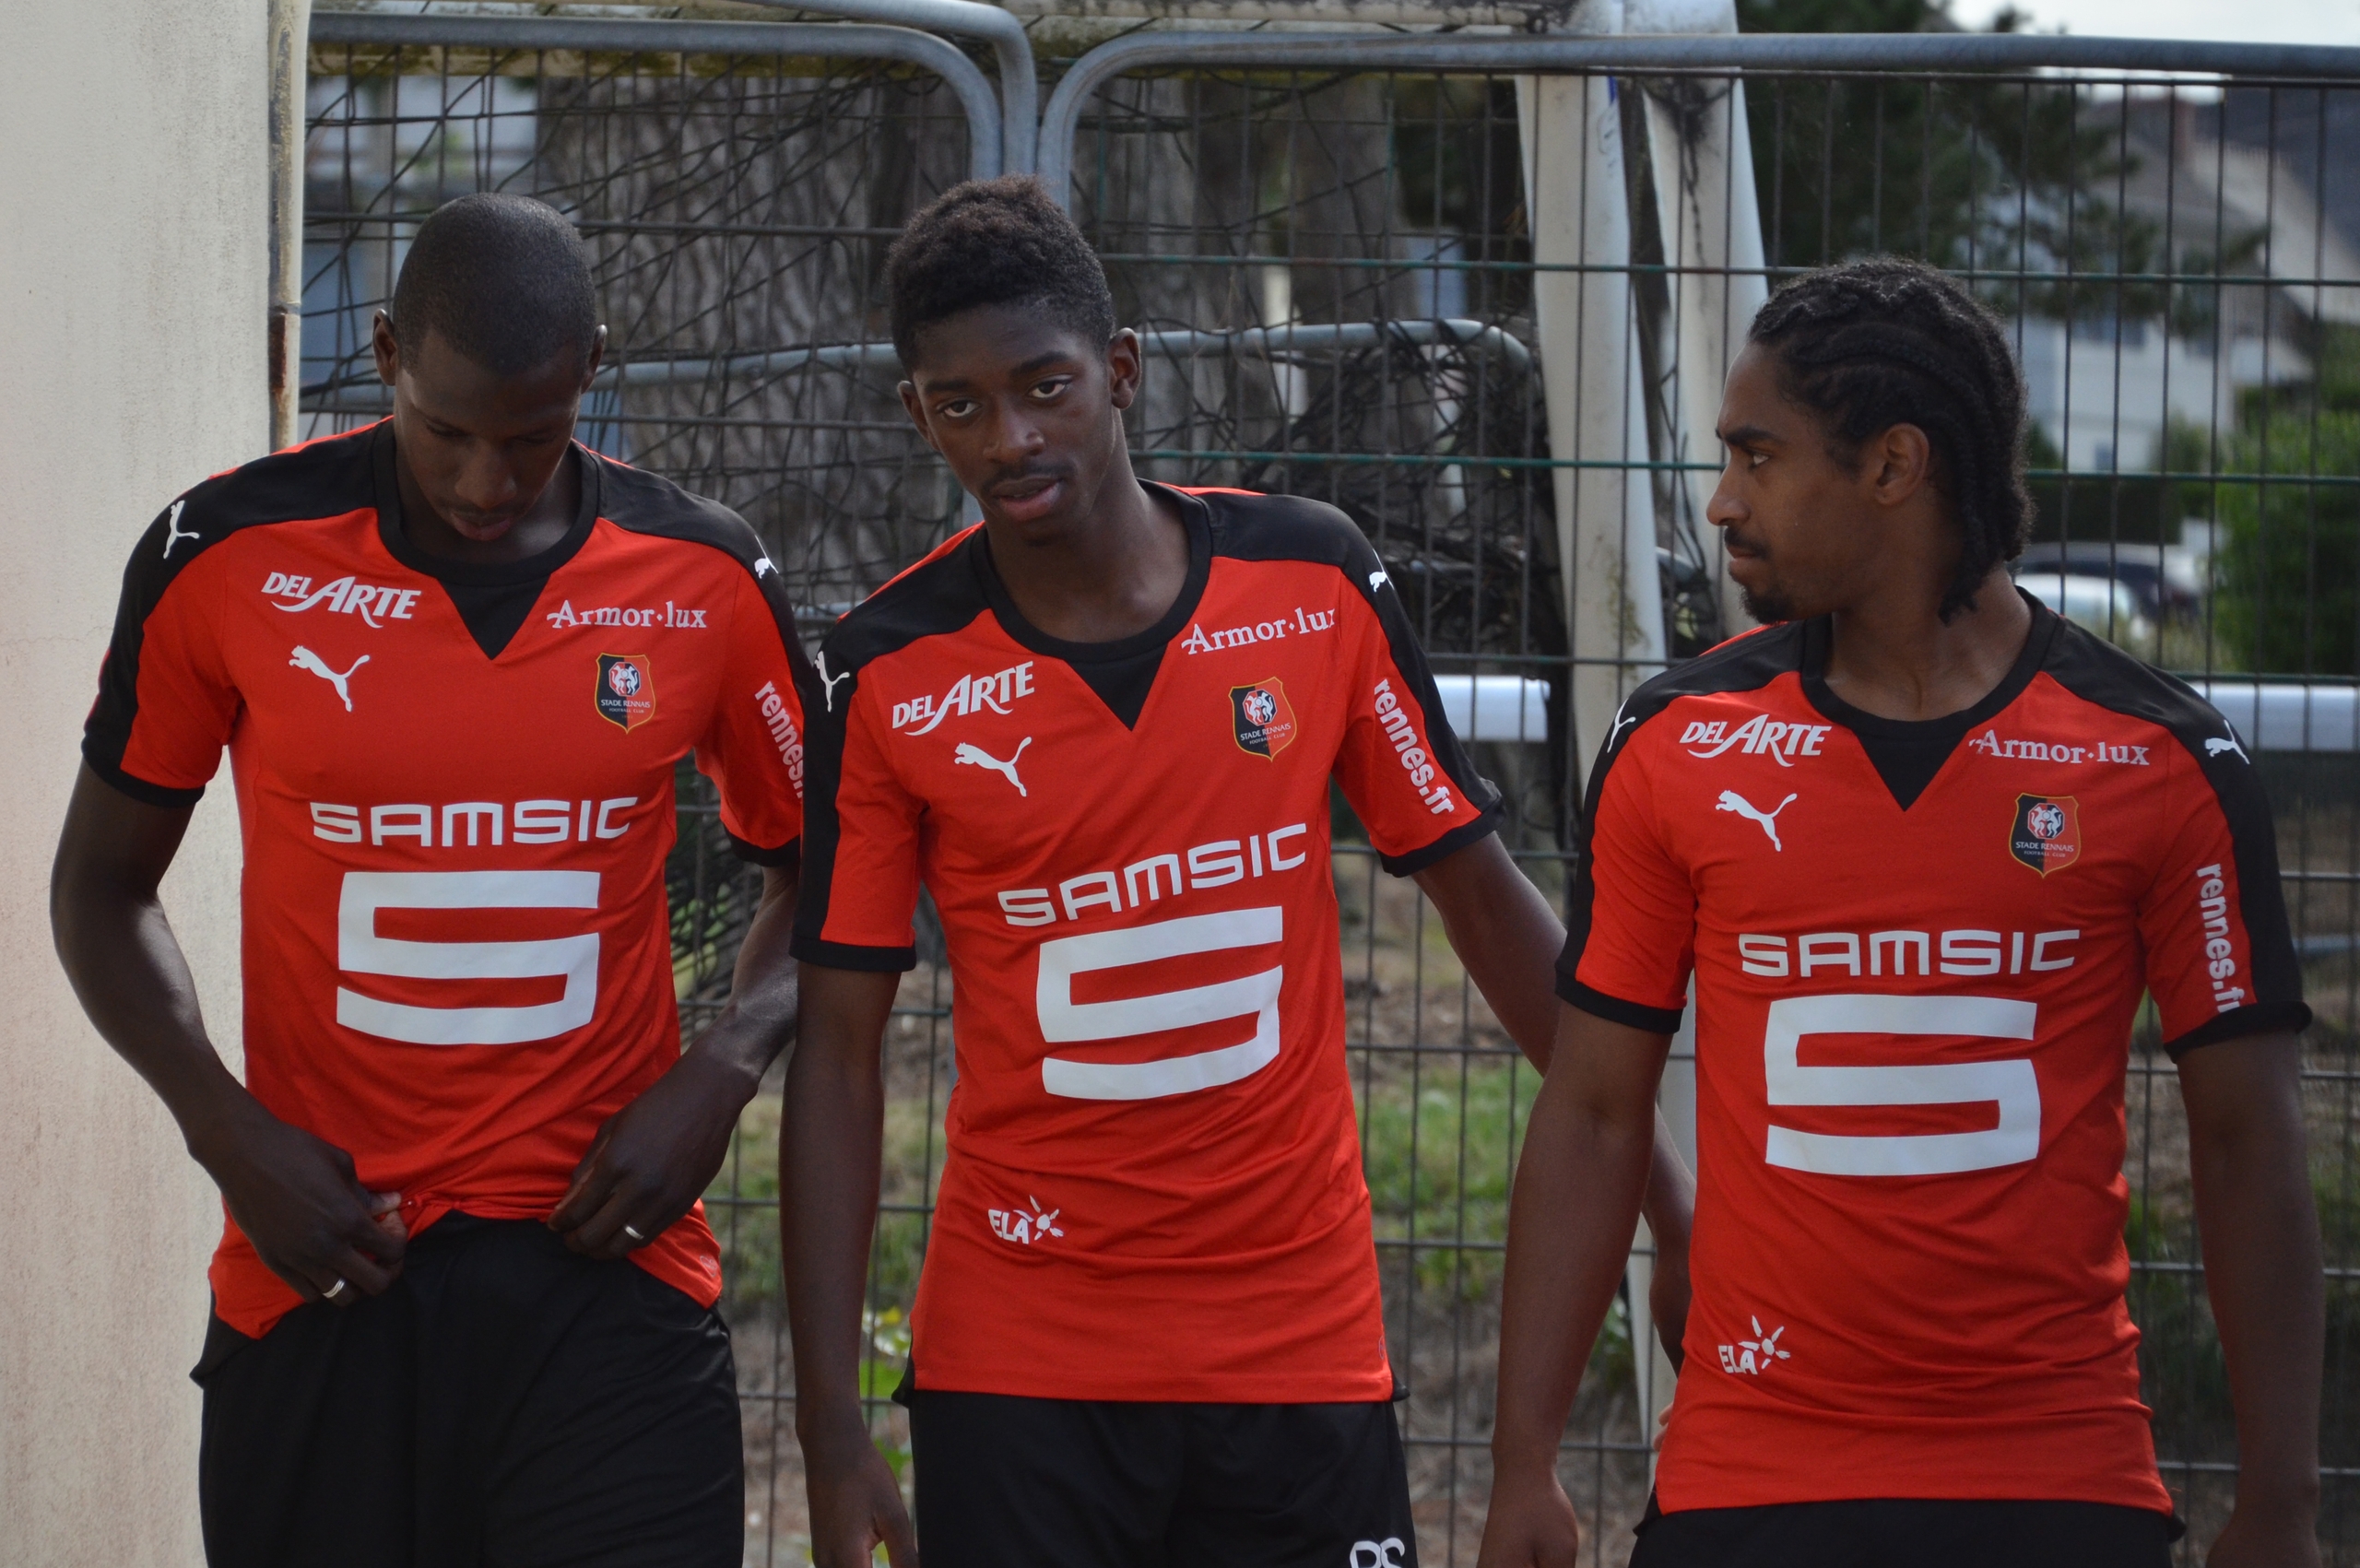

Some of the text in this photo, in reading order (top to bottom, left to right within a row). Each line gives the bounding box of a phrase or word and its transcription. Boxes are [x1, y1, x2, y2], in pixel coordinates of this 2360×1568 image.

[600, 699, 622, 707] STADE
[1240, 723, 1291, 741] STADE RENNAIS
[1374, 678, 1455, 815] rennes.fr
[310, 796, 638, 847] SAMSIC
[2041, 843, 2074, 852] RENNAIS
[997, 822, 1306, 926] SAMSIC
[1739, 929, 2080, 977] SAMSIC
[987, 1208, 1030, 1244] ELA
[1717, 1345, 1758, 1375] ELA
